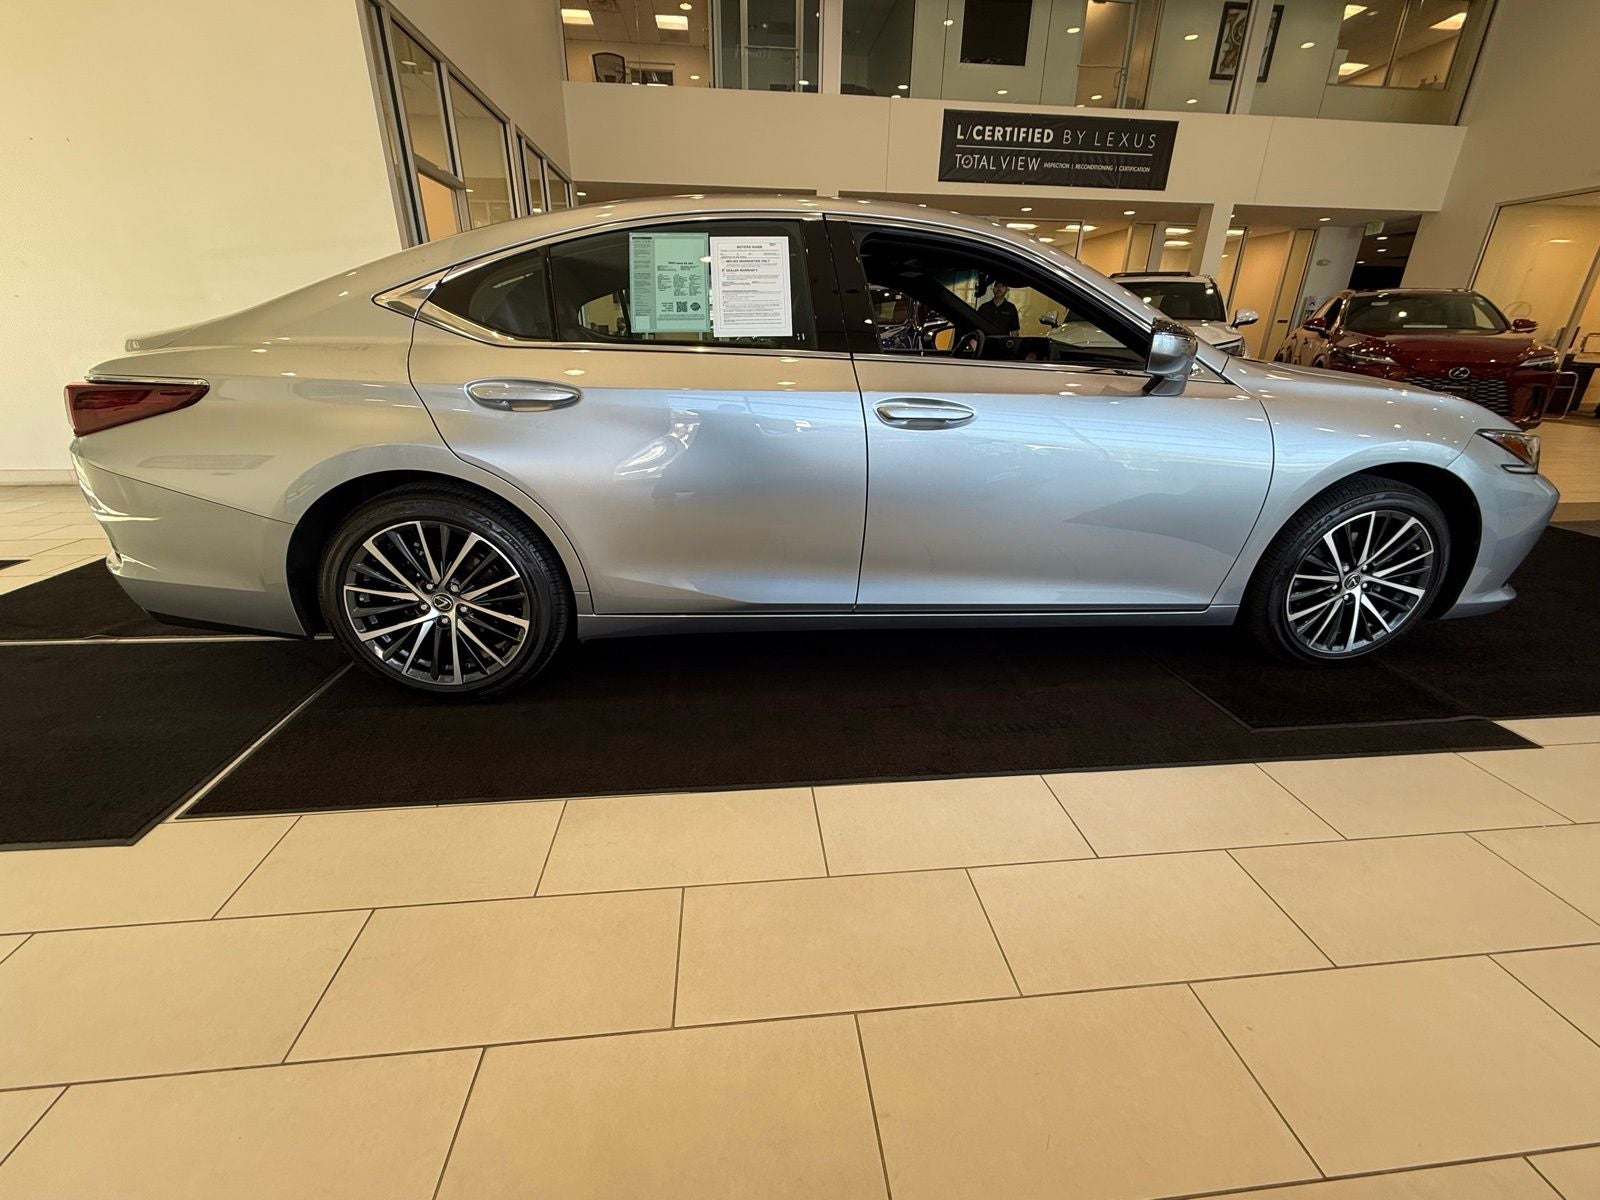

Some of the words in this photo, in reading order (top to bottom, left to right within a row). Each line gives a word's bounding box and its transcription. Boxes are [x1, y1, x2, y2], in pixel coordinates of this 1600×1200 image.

[956, 124, 1054, 143] L/CERTIFIED
[1062, 129, 1087, 145] BY
[1093, 131, 1157, 149] LEXUS
[954, 153, 997, 170] TOTAL
[1000, 154, 1041, 171] VIEW
[1043, 161, 1070, 170] INSPECTION
[1074, 162, 1114, 171] RECONDITIONING
[1118, 164, 1151, 173] CERTIFICATION
